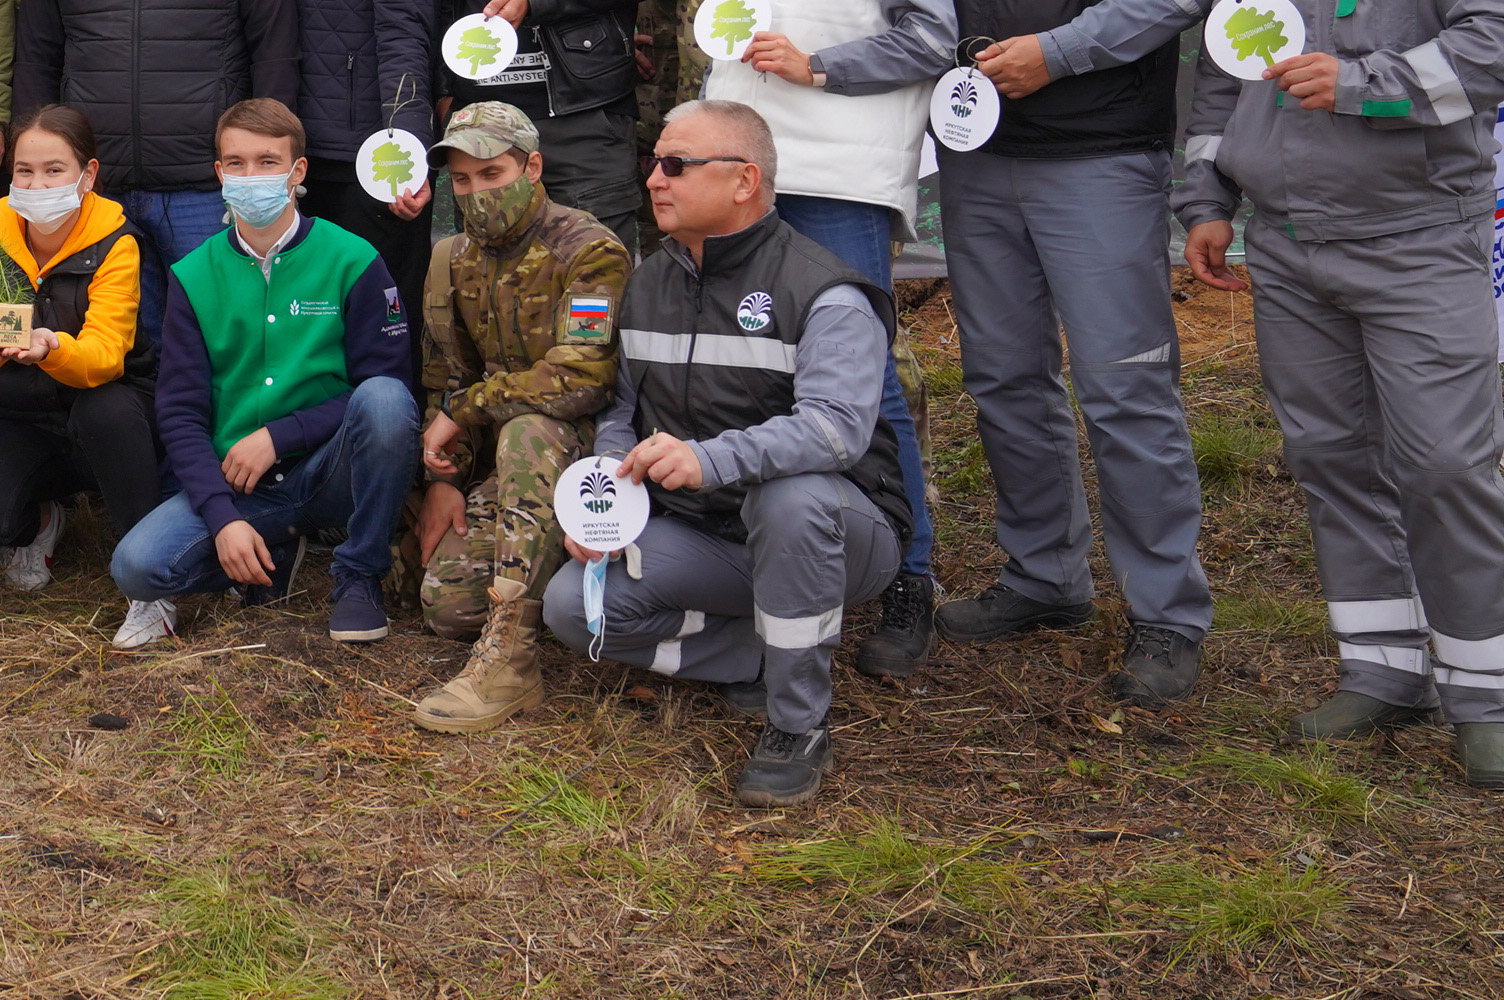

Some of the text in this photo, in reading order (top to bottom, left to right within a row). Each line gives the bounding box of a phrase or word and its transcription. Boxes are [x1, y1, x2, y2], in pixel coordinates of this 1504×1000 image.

[1236, 21, 1276, 41] Сохраним лес
[945, 122, 972, 133] ИРКУТСКАЯ
[945, 129, 969, 139] НЕФТЯНАЯ
[942, 135, 968, 146] КОМПАНИЯ
